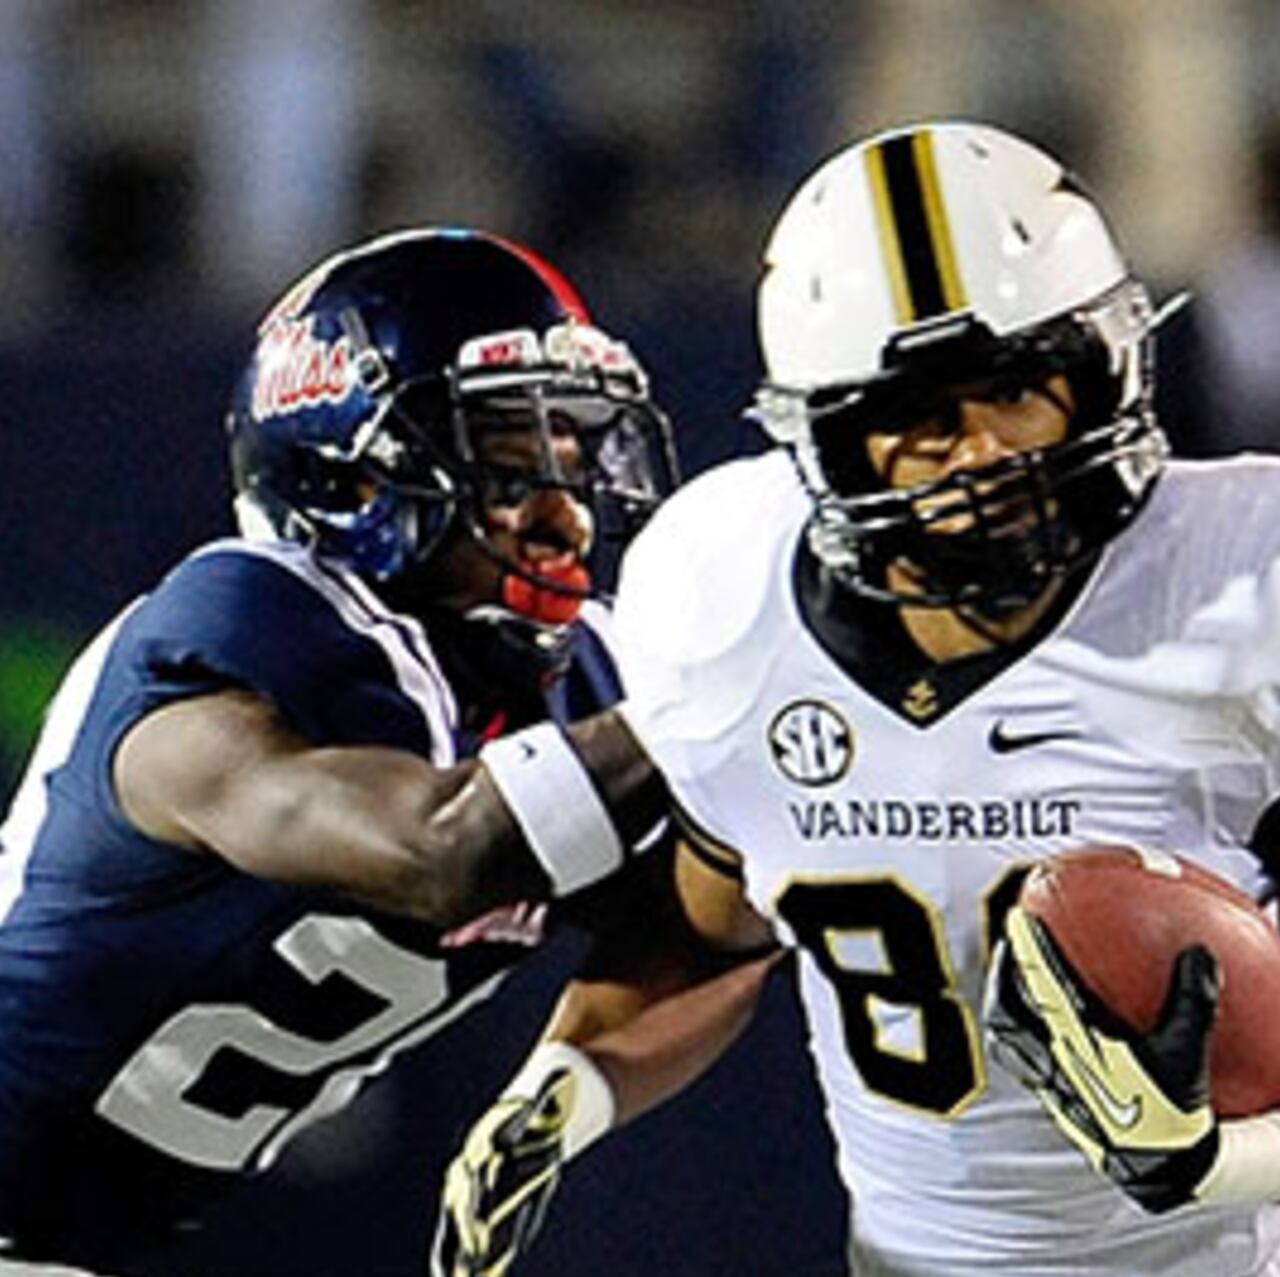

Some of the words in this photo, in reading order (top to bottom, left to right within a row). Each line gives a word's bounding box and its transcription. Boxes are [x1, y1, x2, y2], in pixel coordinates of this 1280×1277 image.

[790, 800, 1080, 840] VANDERBILT
[95, 912, 510, 1172] 2
[775, 863, 1032, 1120] 8
